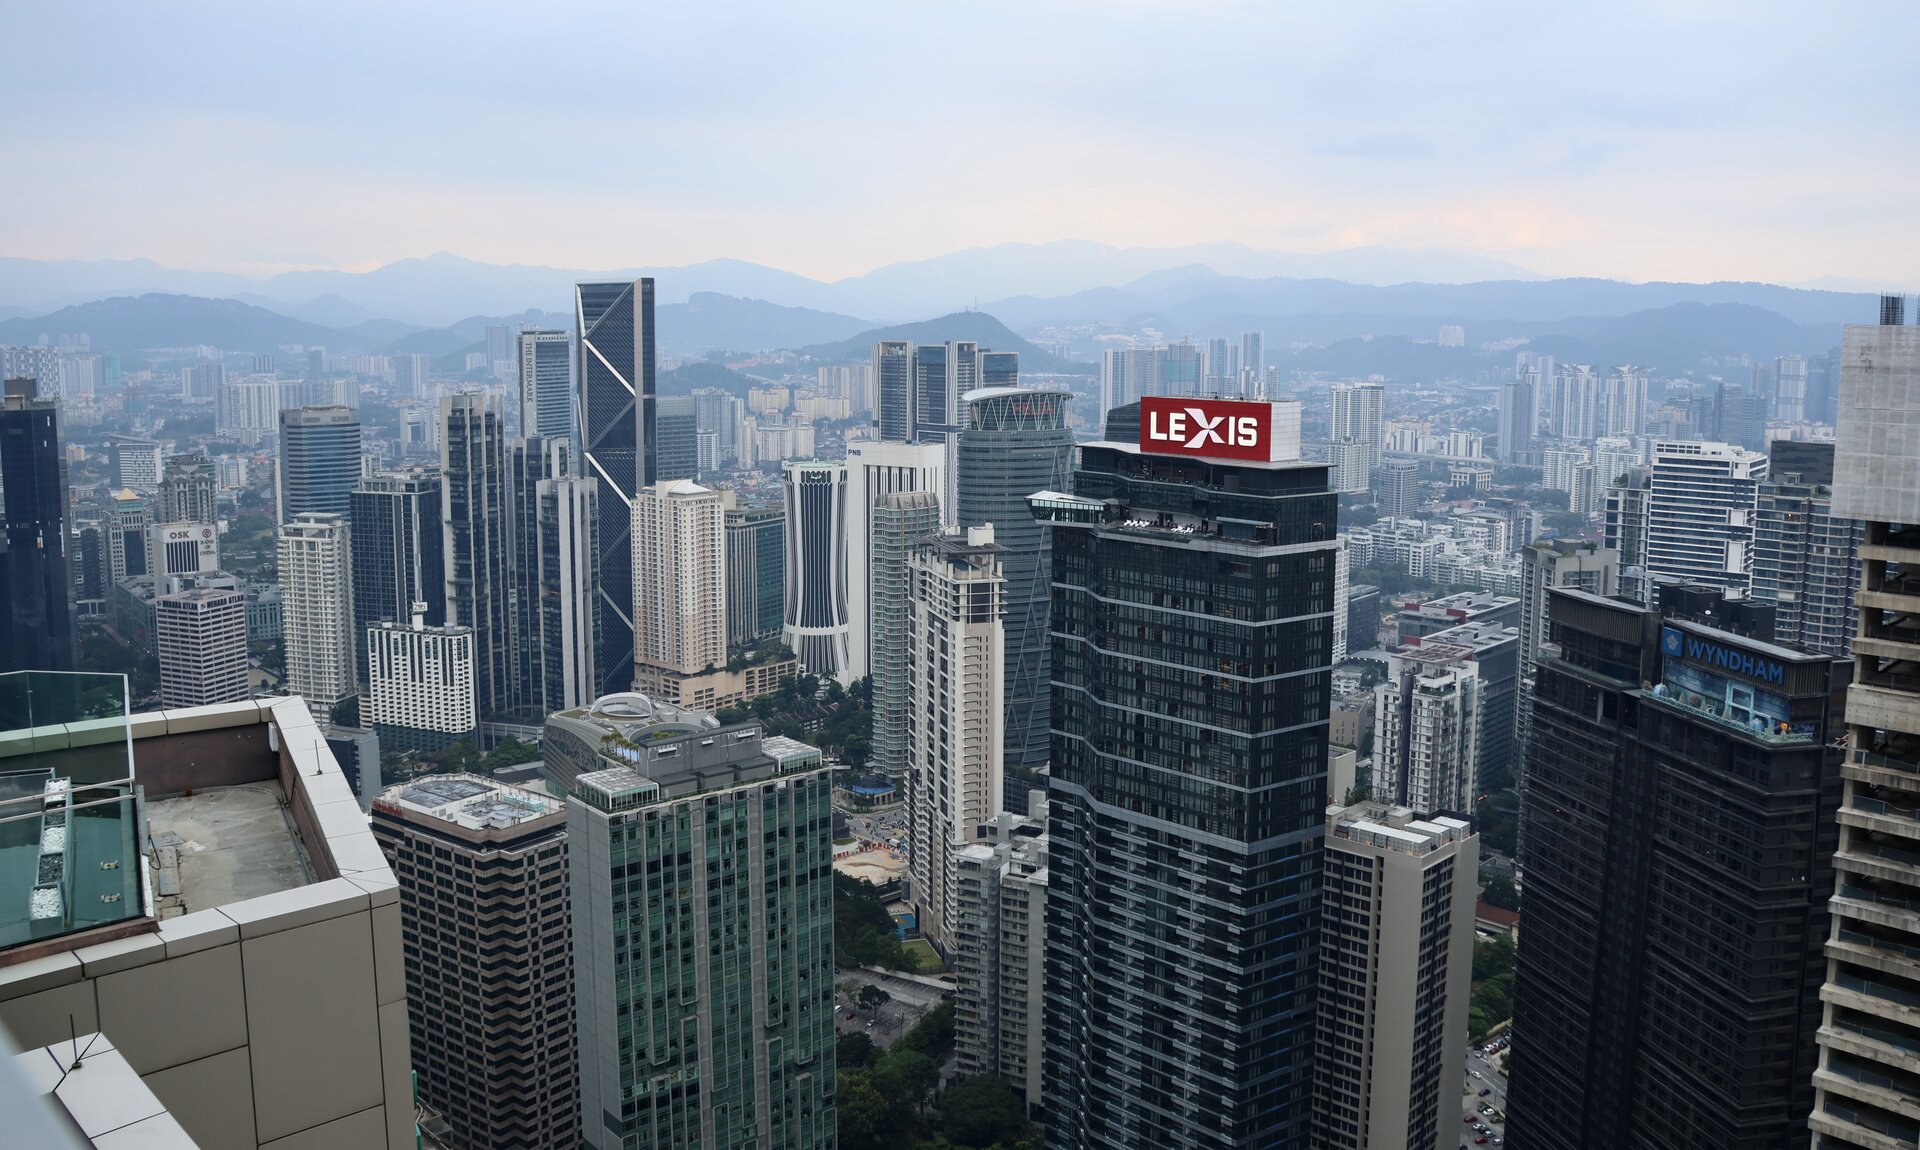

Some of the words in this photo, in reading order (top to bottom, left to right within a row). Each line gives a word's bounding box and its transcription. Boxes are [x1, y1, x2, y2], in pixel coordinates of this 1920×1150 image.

[525, 343, 533, 356] THE
[525, 358, 534, 403] INTERMARK
[1149, 407, 1258, 449] LEXIS
[169, 531, 189, 540] OSK
[206, 598, 227, 609] MENARA
[1688, 638, 1784, 684] WYNDHAM
